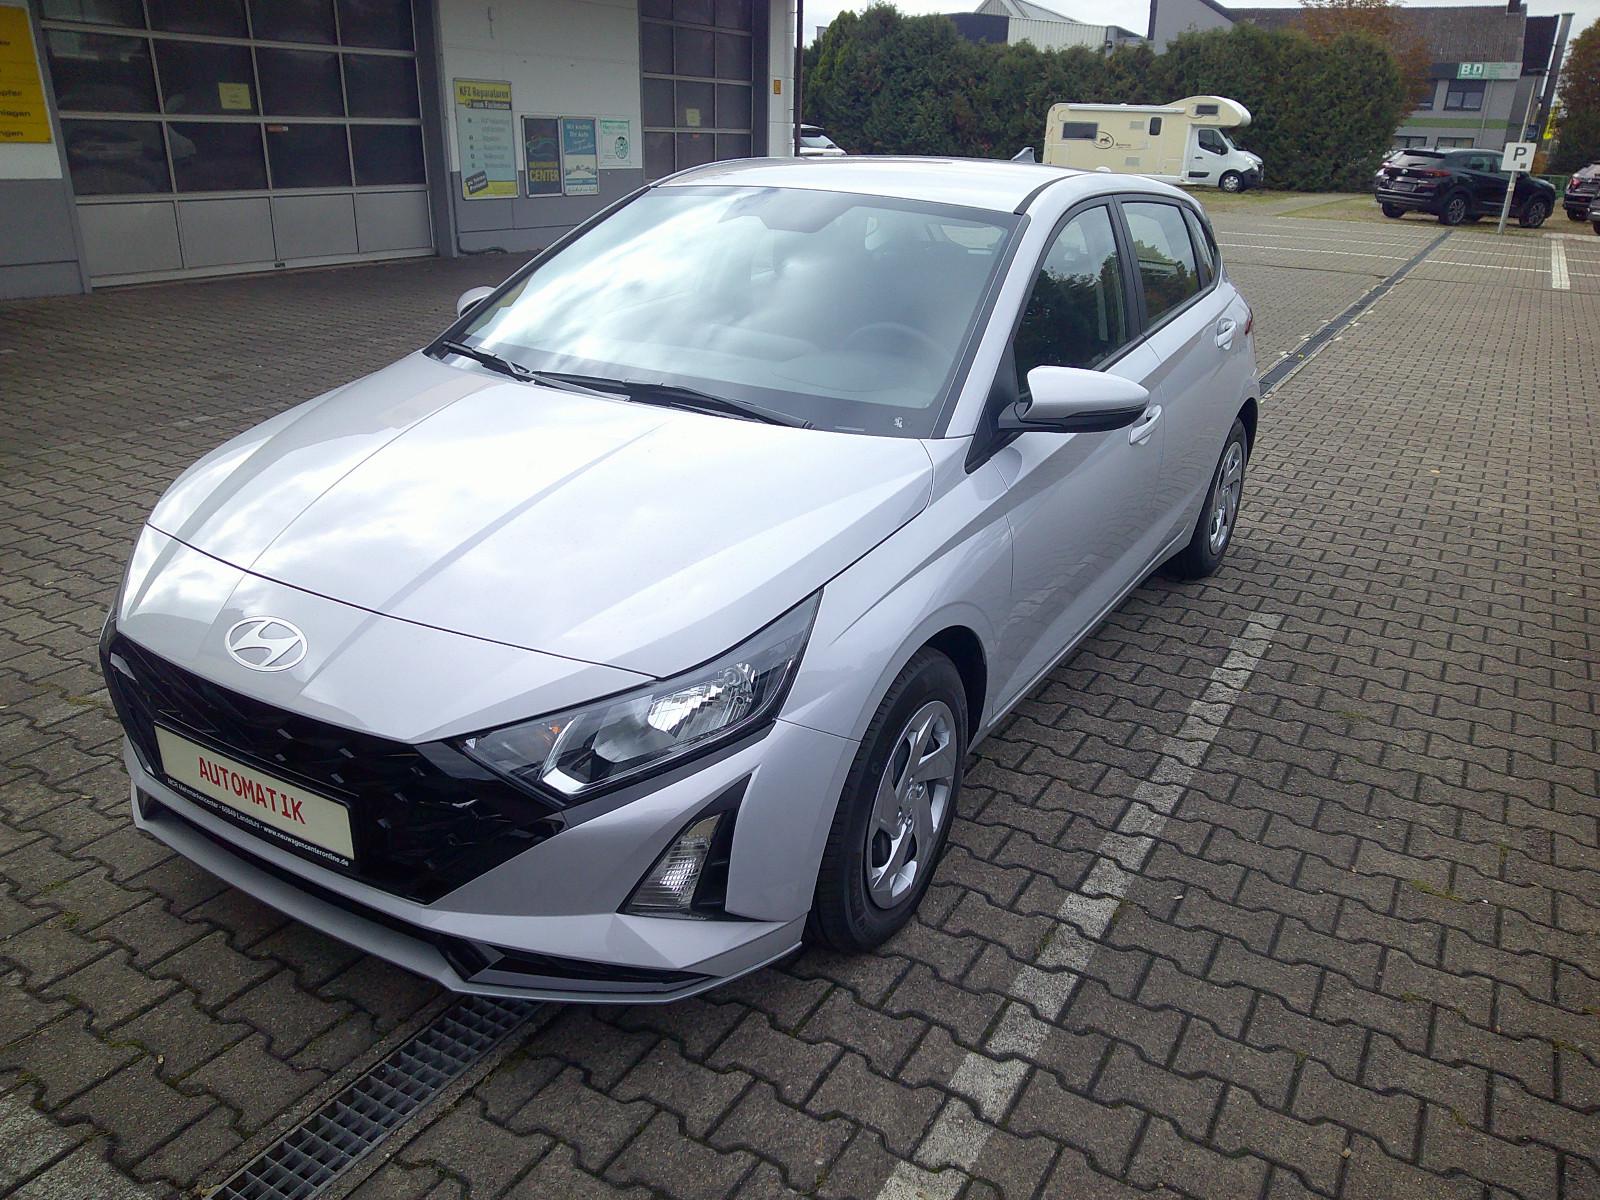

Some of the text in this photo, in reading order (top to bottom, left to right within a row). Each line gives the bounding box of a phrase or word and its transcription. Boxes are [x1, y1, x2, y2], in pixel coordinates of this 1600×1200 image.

[1513, 147, 1527, 161] P
[529, 169, 560, 182] CENTER
[199, 756, 306, 825] AUTOMATIK
